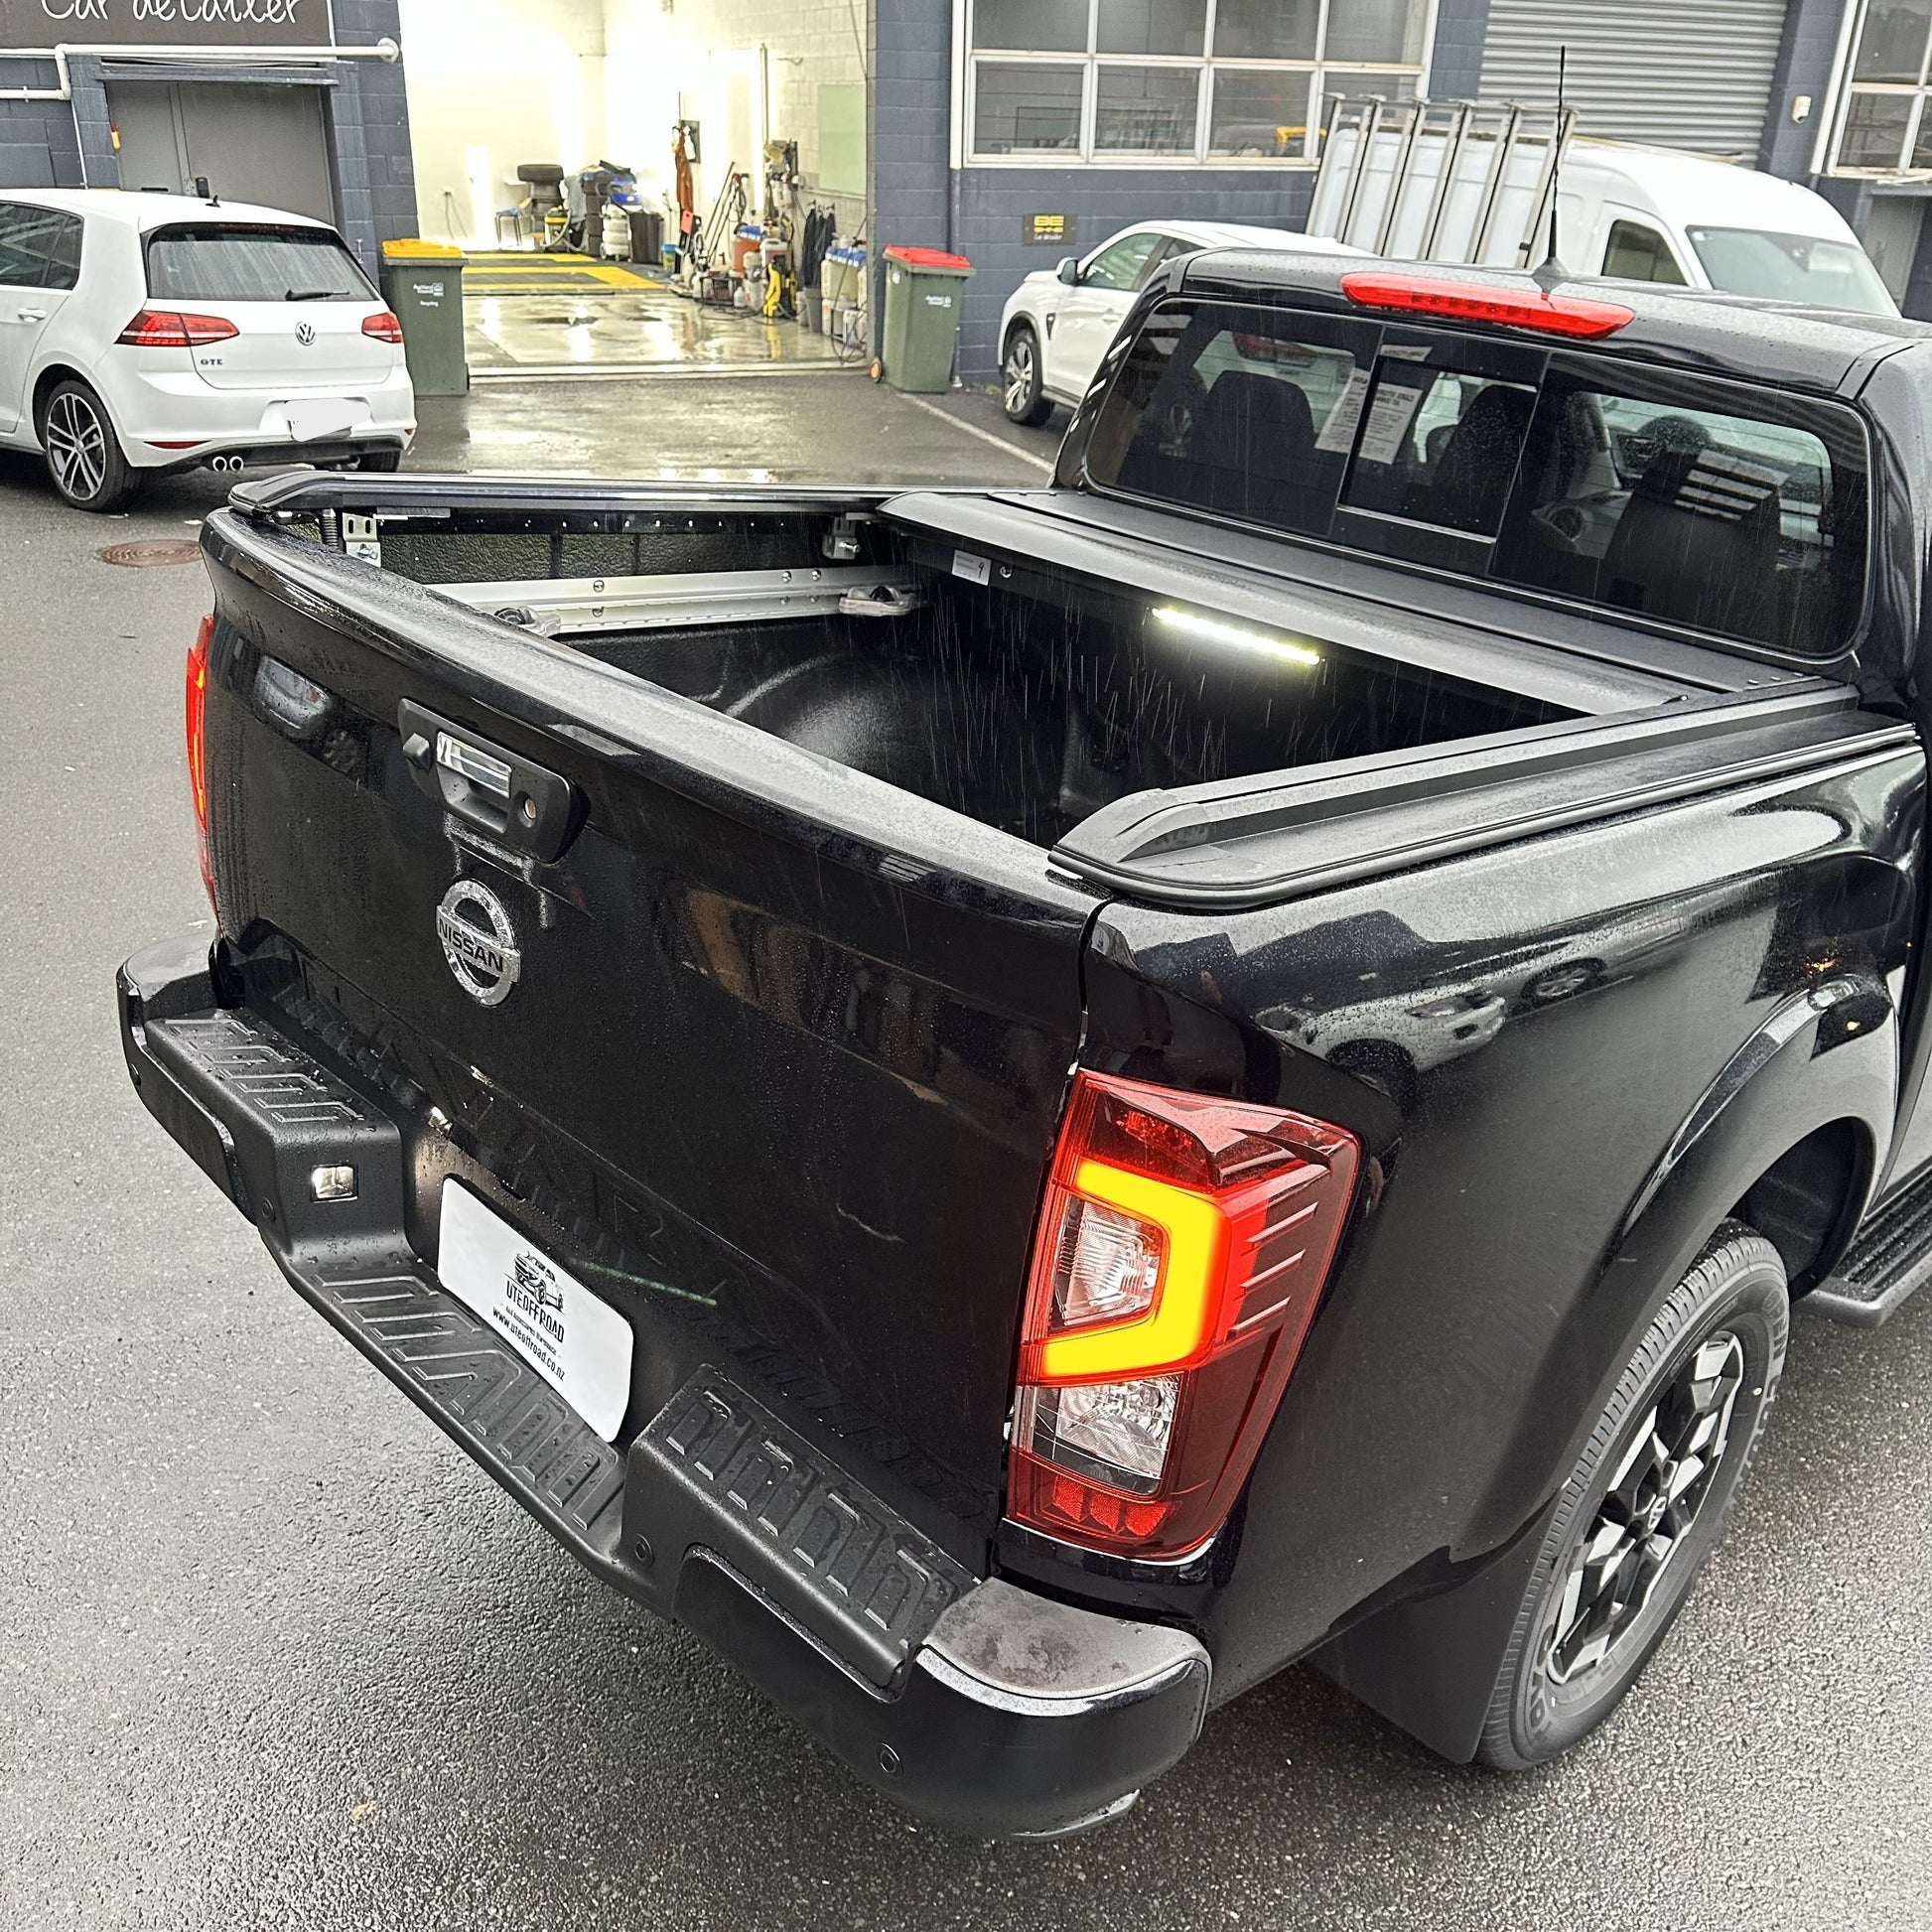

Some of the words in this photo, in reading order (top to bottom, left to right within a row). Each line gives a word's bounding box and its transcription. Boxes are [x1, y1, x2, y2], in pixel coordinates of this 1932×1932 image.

[439, 917, 504, 973] NISSAN
[506, 1280, 565, 1343] UTEOFFROAD
[492, 1307, 566, 1382] www.uteoffroad.co.nz
